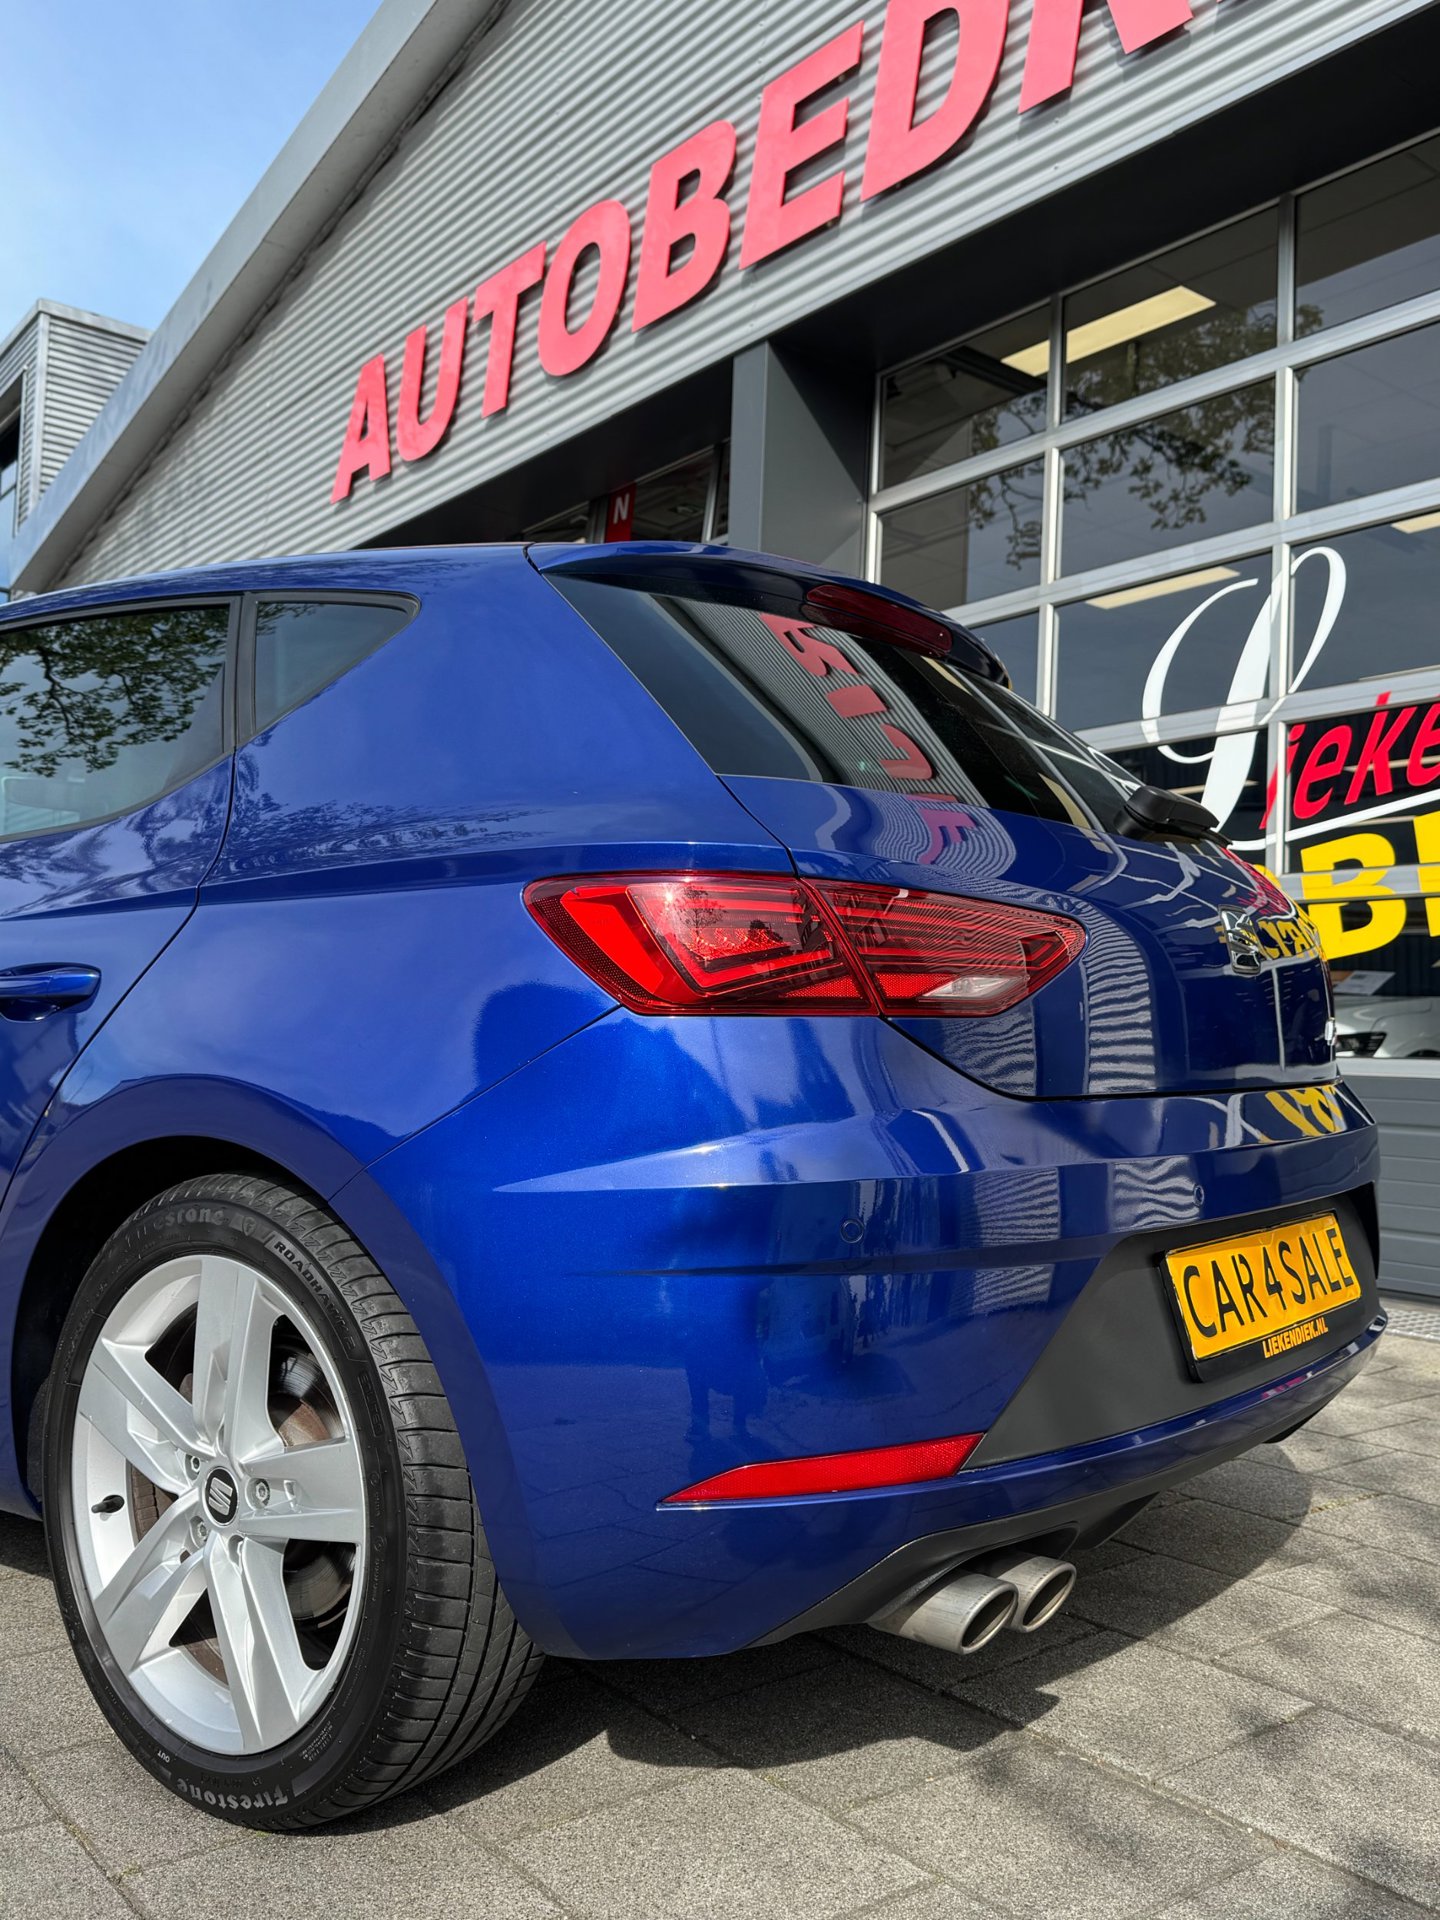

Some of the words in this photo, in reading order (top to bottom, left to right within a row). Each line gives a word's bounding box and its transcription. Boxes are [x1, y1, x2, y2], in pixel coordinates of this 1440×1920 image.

[1183, 1228, 1355, 1339] CAR4SALE
[1262, 1316, 1329, 1359] LIEKENDIEK.NL
[157, 1749, 171, 1763] OUT
[176, 1778, 289, 1810] Firestone
